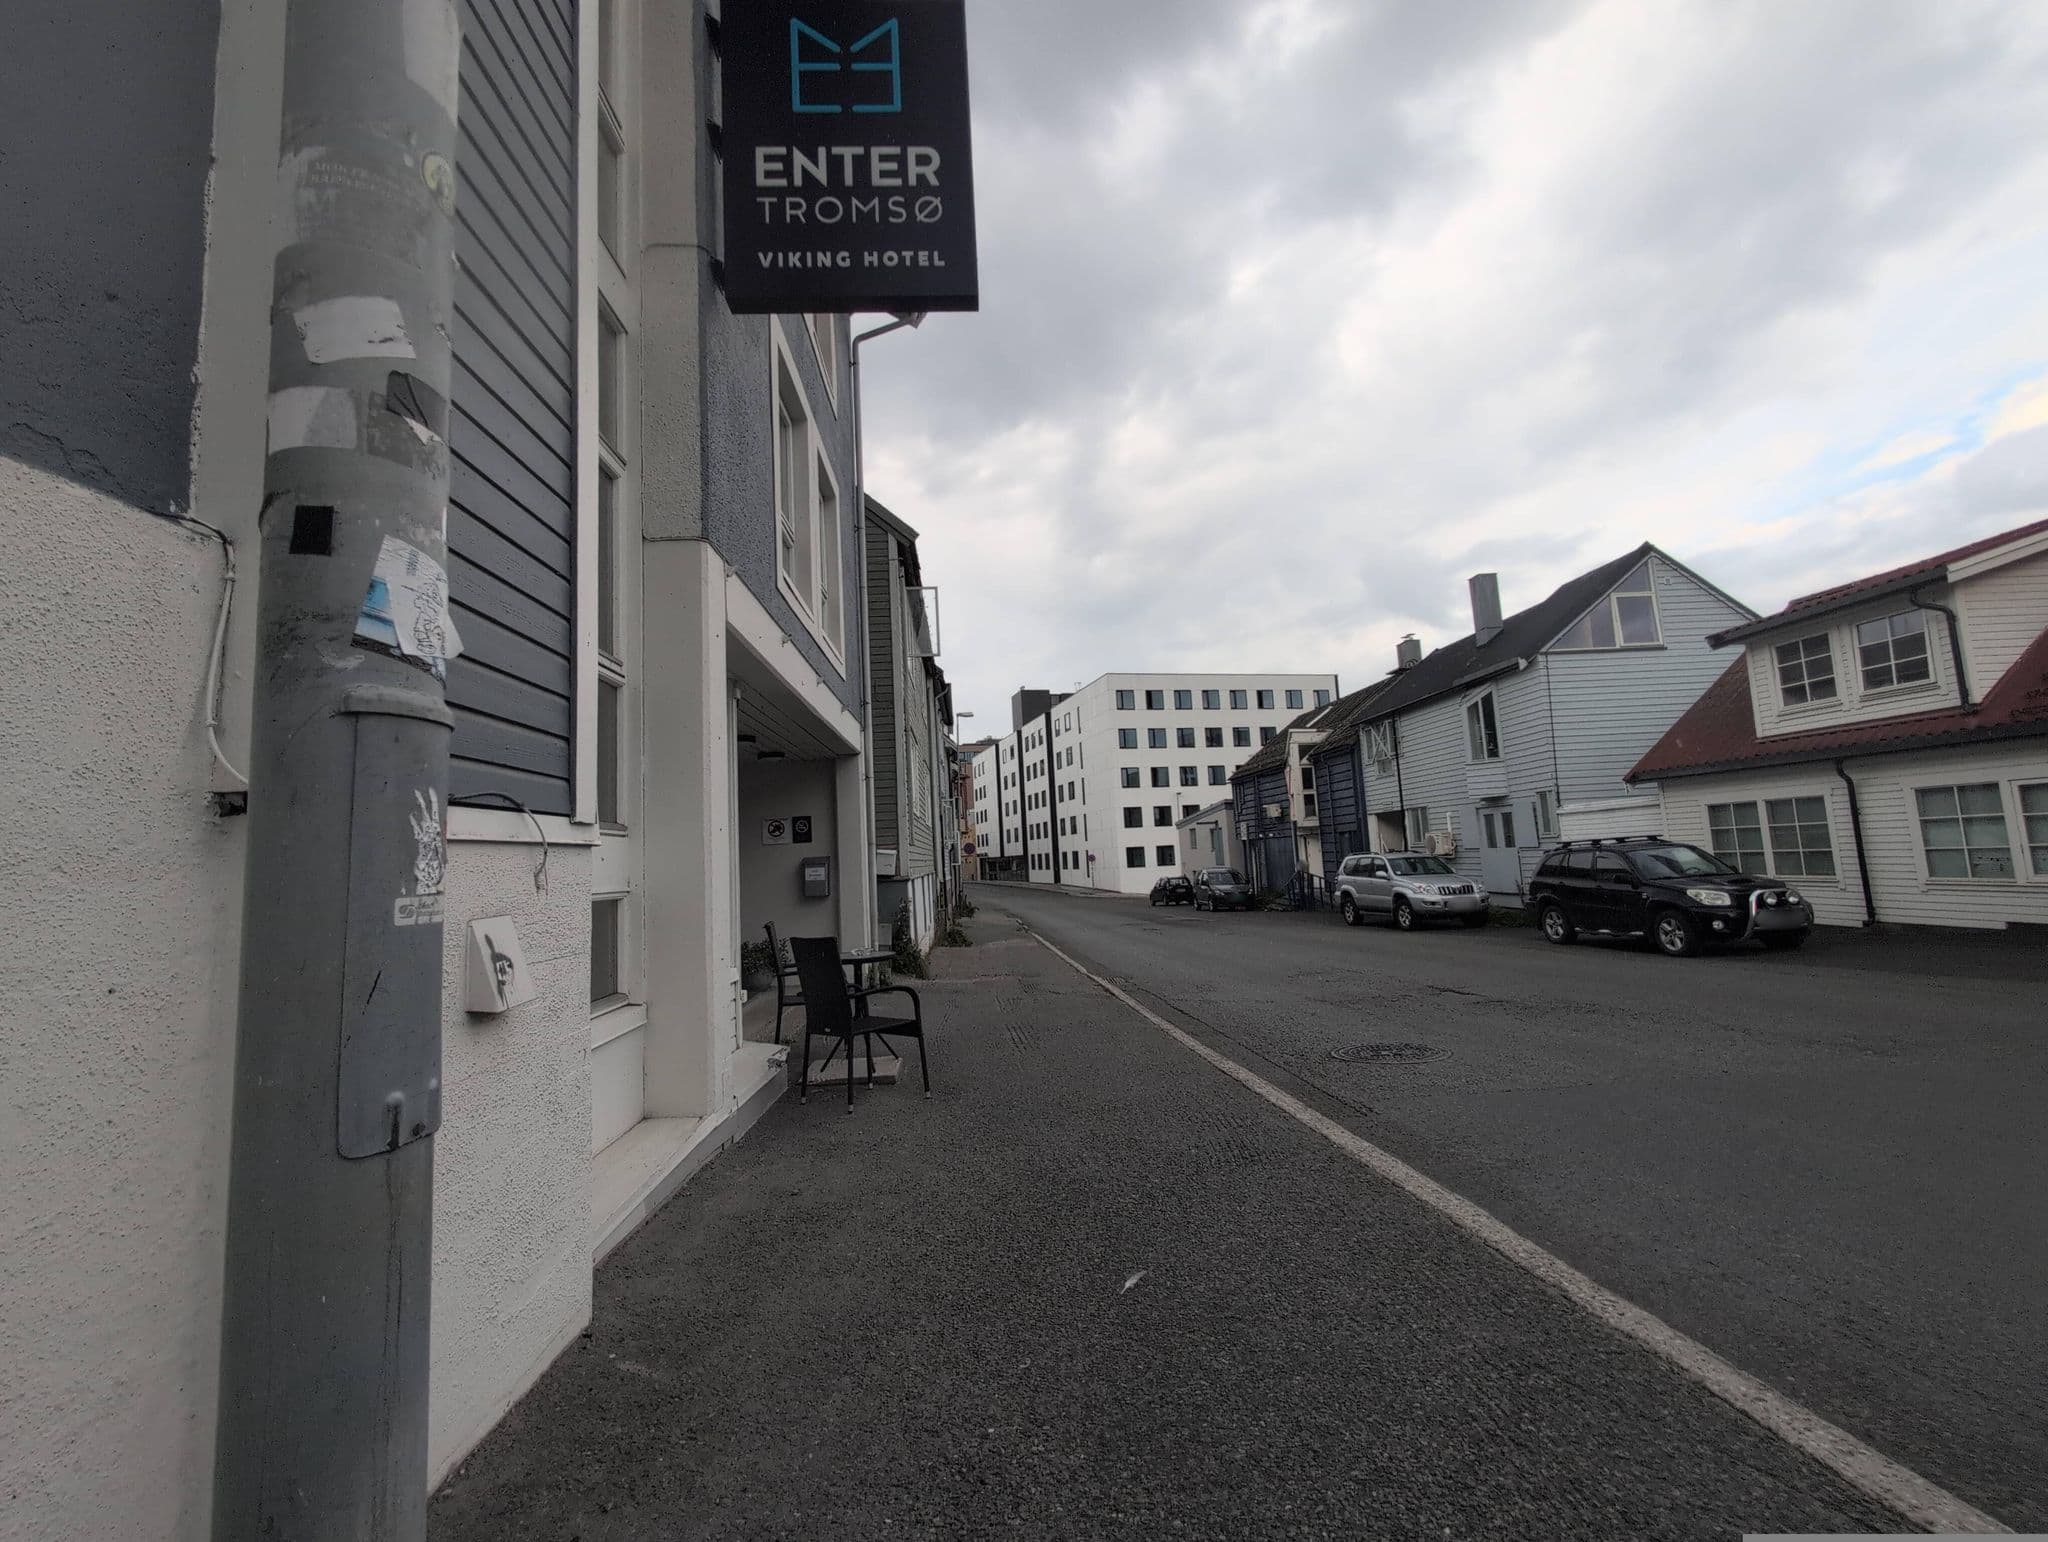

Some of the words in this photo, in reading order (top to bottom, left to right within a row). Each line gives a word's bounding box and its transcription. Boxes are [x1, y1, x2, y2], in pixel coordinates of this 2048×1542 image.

[755, 146, 941, 187] ENTER
[756, 195, 943, 224] TROMSØ
[758, 251, 851, 268] VIKING
[864, 250, 946, 267] HOTEL
